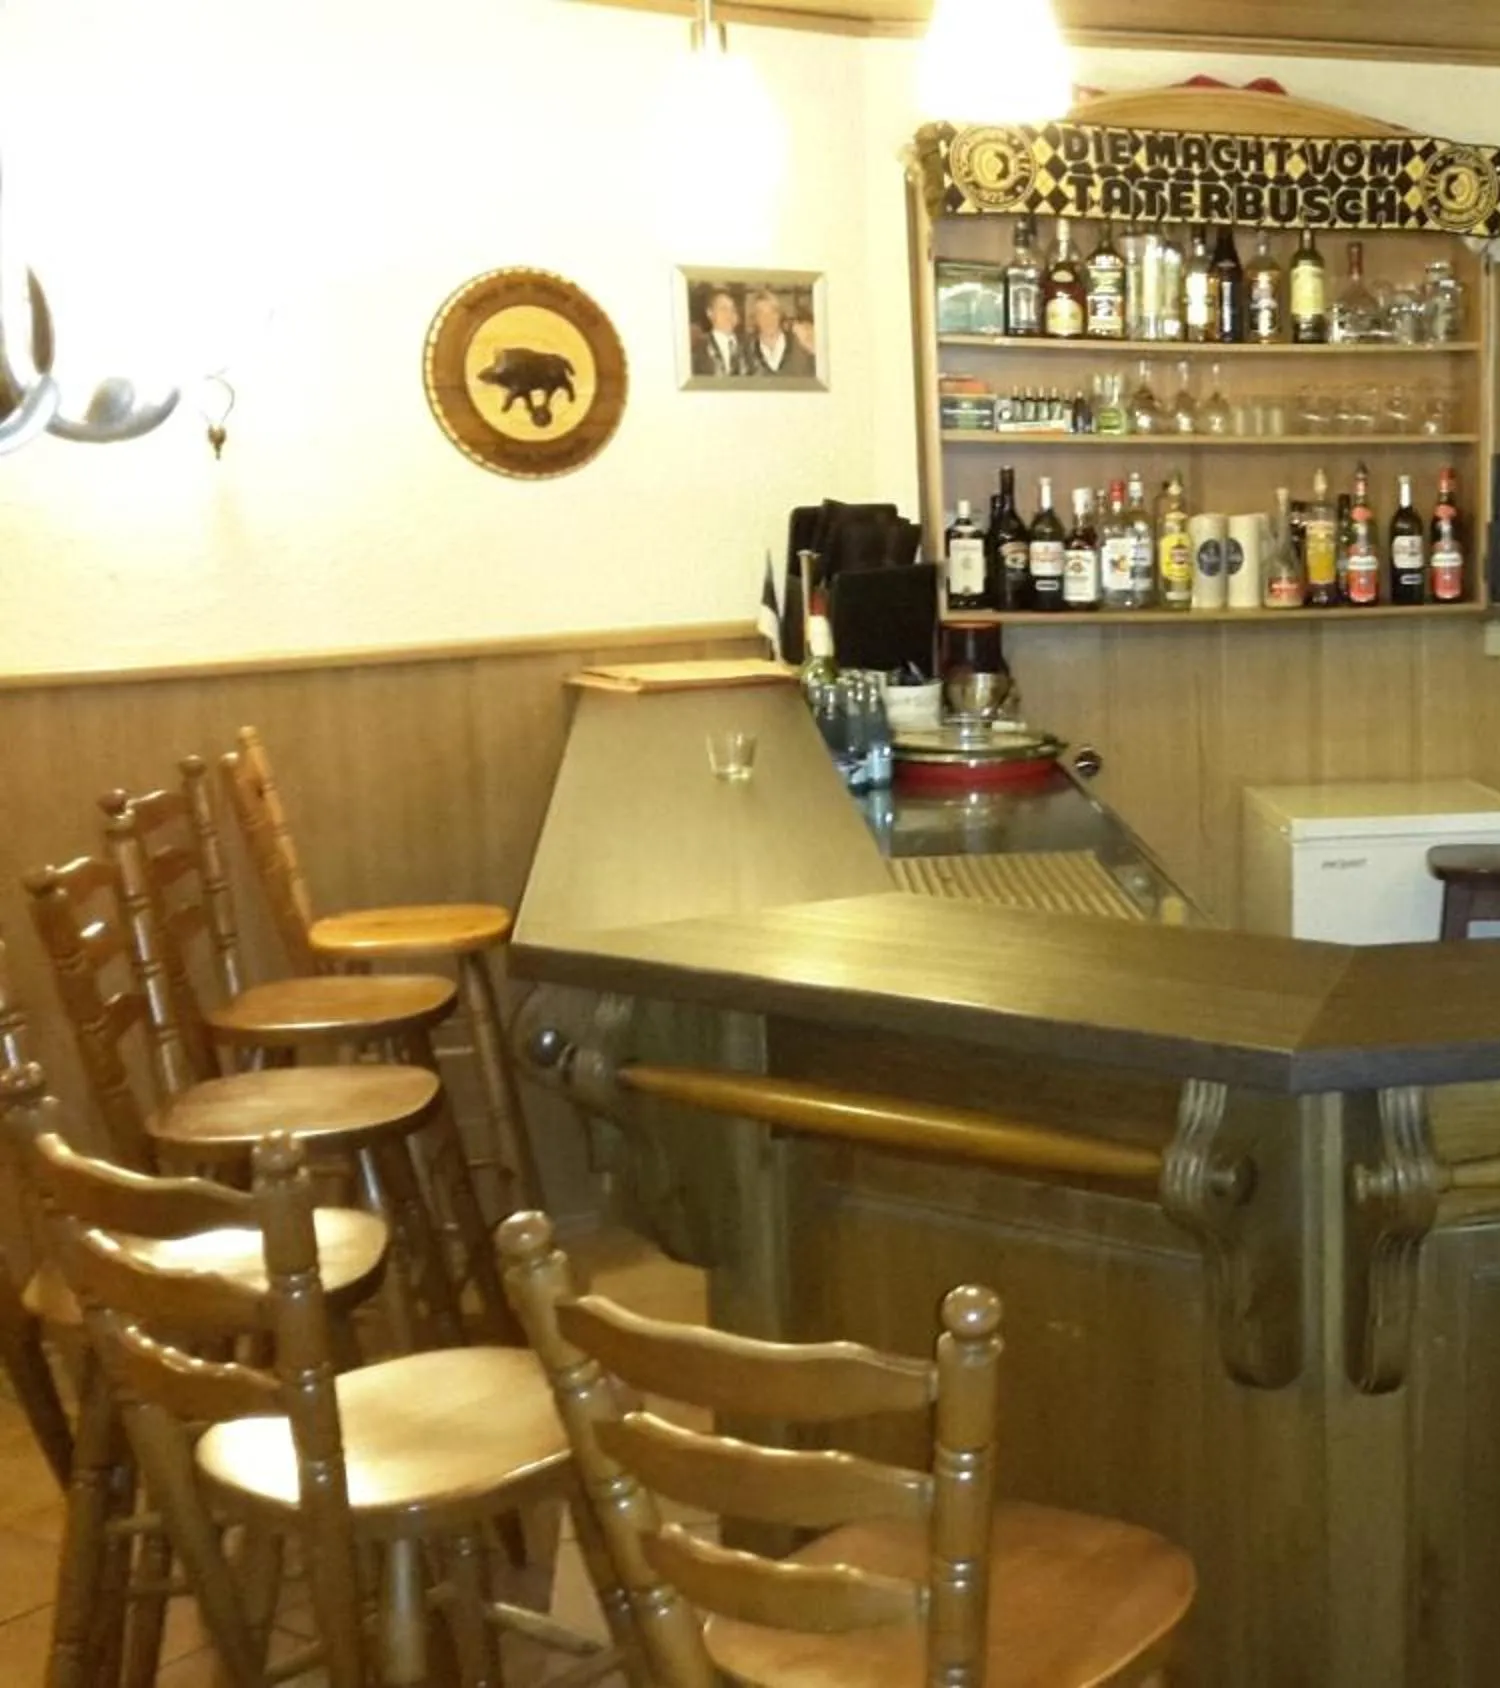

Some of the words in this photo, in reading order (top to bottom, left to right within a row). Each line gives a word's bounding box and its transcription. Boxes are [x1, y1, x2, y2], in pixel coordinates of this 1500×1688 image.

[1062, 127, 1131, 166] DIE
[1146, 132, 1291, 174] MACHT
[1307, 139, 1400, 177] VOM
[1066, 176, 1398, 226] TATERBUSCH
